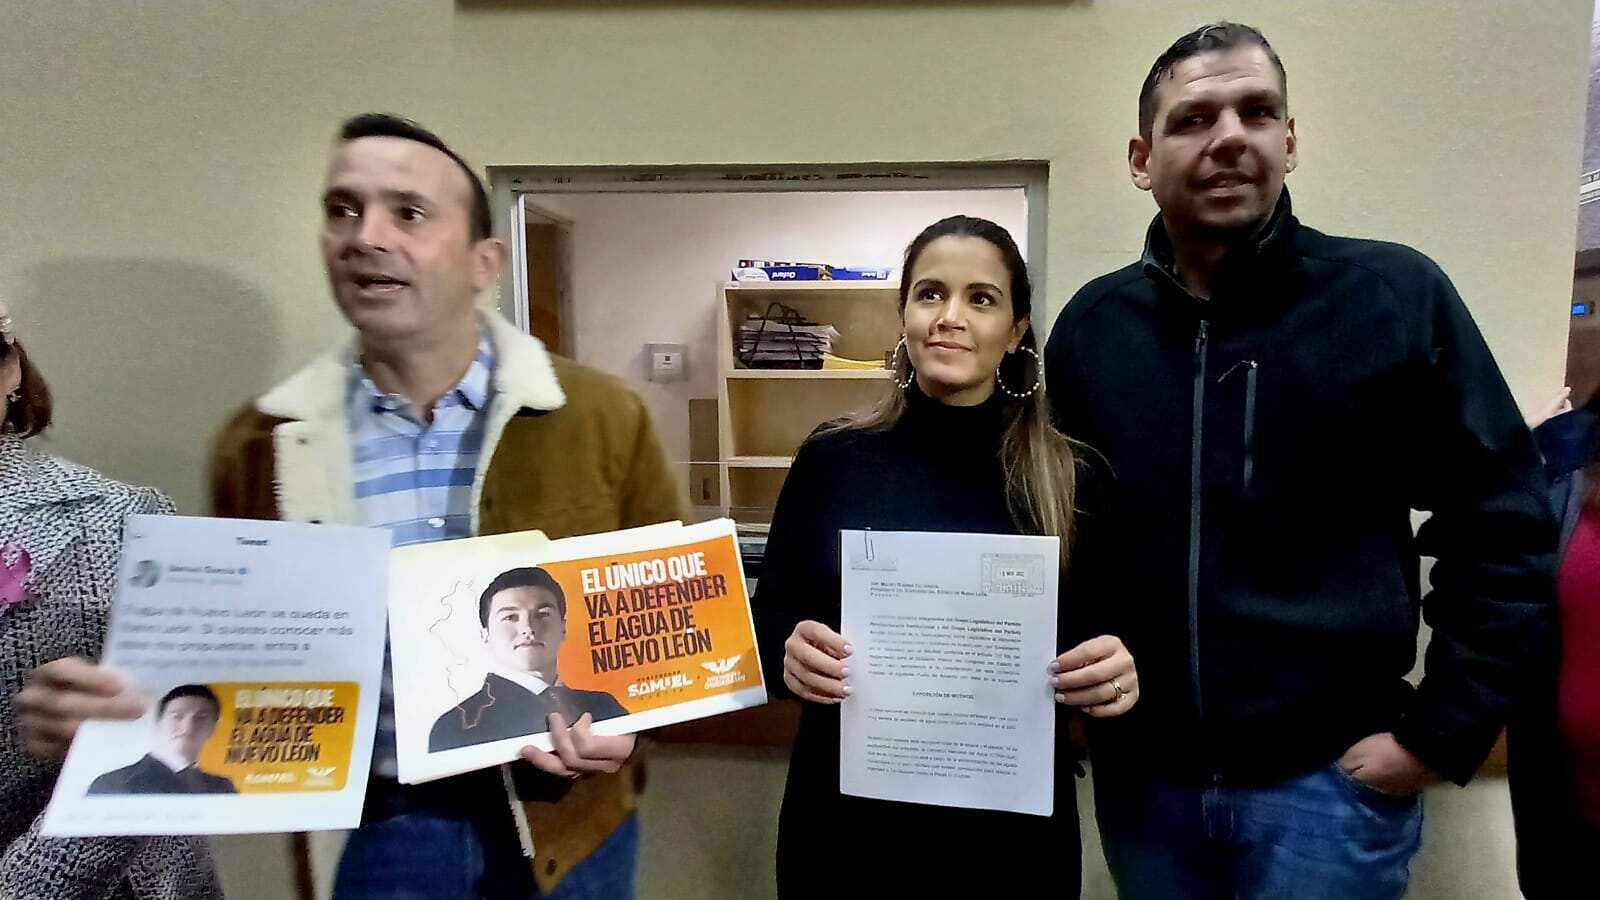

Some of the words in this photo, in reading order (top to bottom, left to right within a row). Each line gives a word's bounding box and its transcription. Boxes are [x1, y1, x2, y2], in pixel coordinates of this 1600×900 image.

[580, 568, 606, 594] EL
[605, 559, 667, 590] ÚNICO
[667, 551, 708, 583] QUE
[290, 608, 330, 620] queda
[584, 593, 613, 620] VA
[615, 590, 630, 615] A
[630, 574, 728, 612] DEFENDER
[588, 620, 612, 647] EL
[615, 611, 669, 643] AGUA
[670, 606, 697, 632] DE
[591, 637, 660, 674] NUEVO
[663, 628, 713, 660] LEÓN
[293, 724, 314, 742] DE
